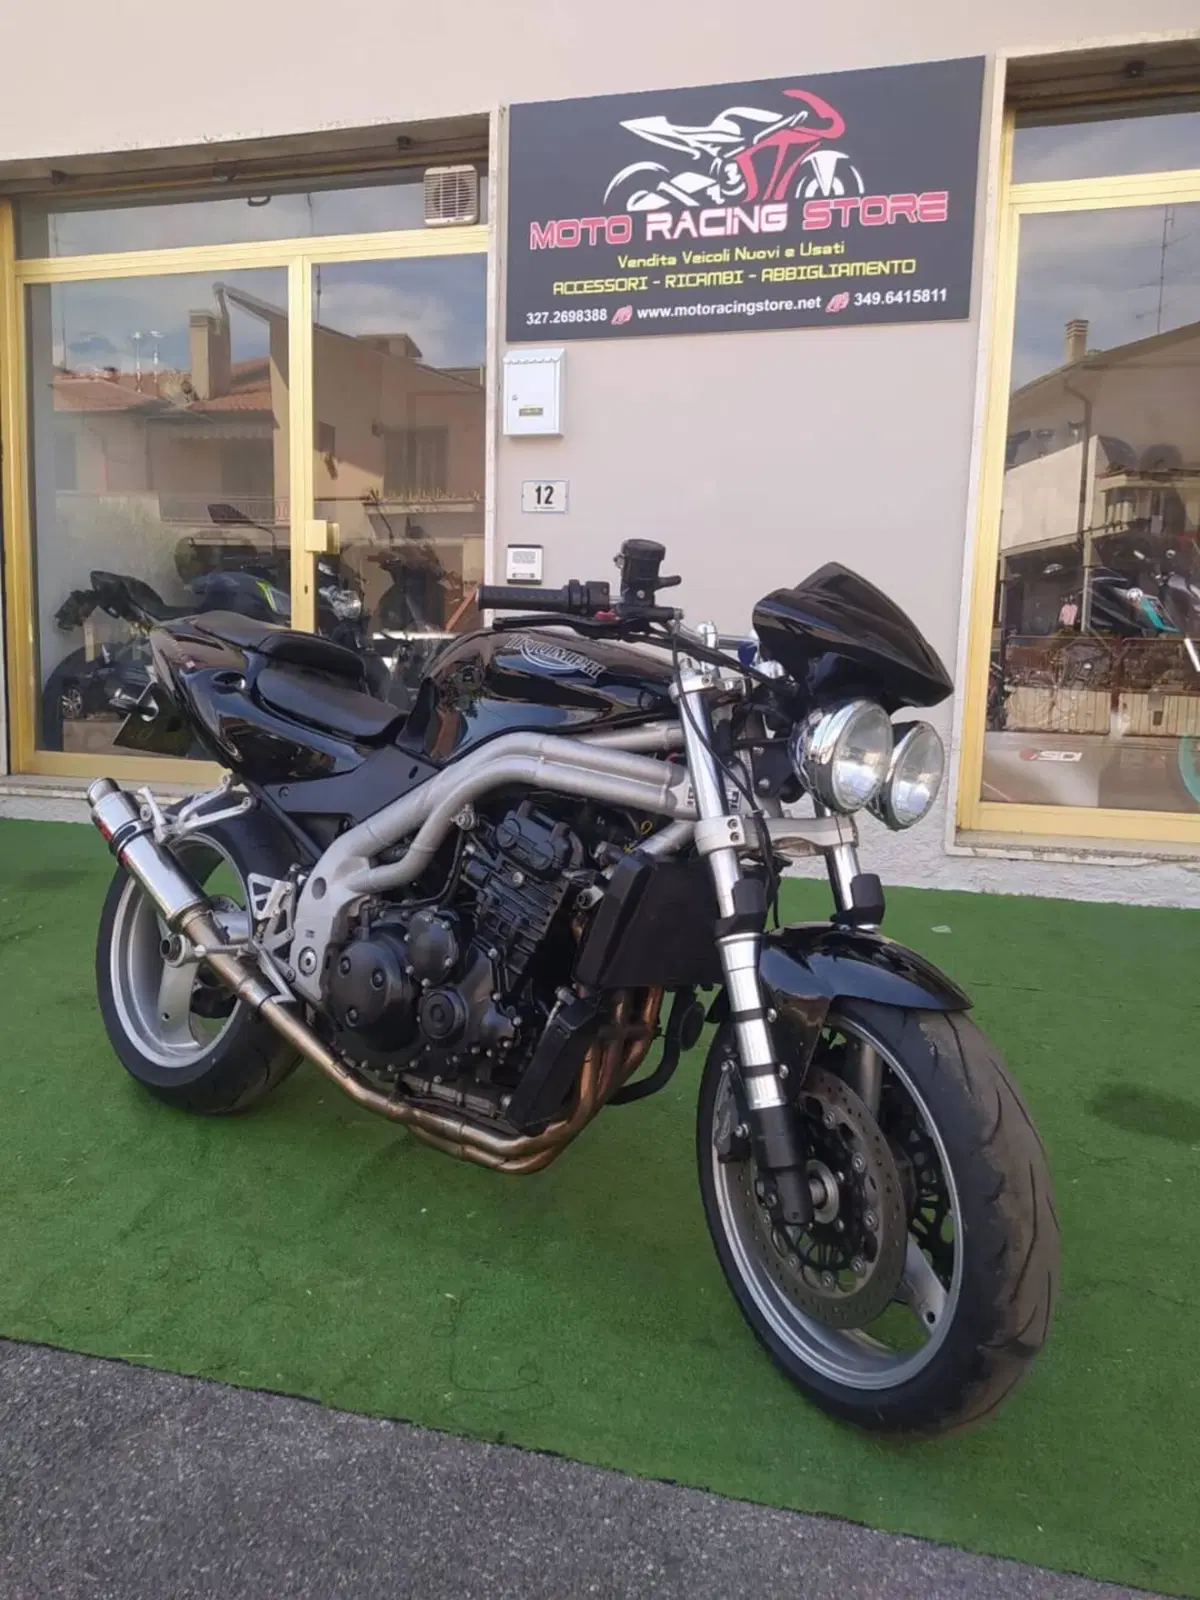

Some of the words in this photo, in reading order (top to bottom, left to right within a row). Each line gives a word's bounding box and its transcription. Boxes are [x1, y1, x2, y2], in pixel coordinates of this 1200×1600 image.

[529, 215, 632, 250] MOTO
[646, 203, 788, 241] RACING
[802, 191, 948, 230] STORE
[617, 254, 676, 269] Vendita
[682, 249, 730, 265] Veicoli
[734, 245, 780, 261] Nuovi
[784, 248, 795, 258] e
[799, 241, 845, 256] Usati
[553, 276, 648, 295] ACCESSORI
[665, 270, 744, 288] RICAMBI
[761, 259, 916, 283] ABBIGLIAMENTO
[526, 308, 607, 325] 327.2698388
[637, 296, 822, 319] www.motoracingstore.net
[854, 287, 948, 306] 349.6415811
[535, 485, 554, 505] 12
[504, 633, 606, 679] TRIUMPH
